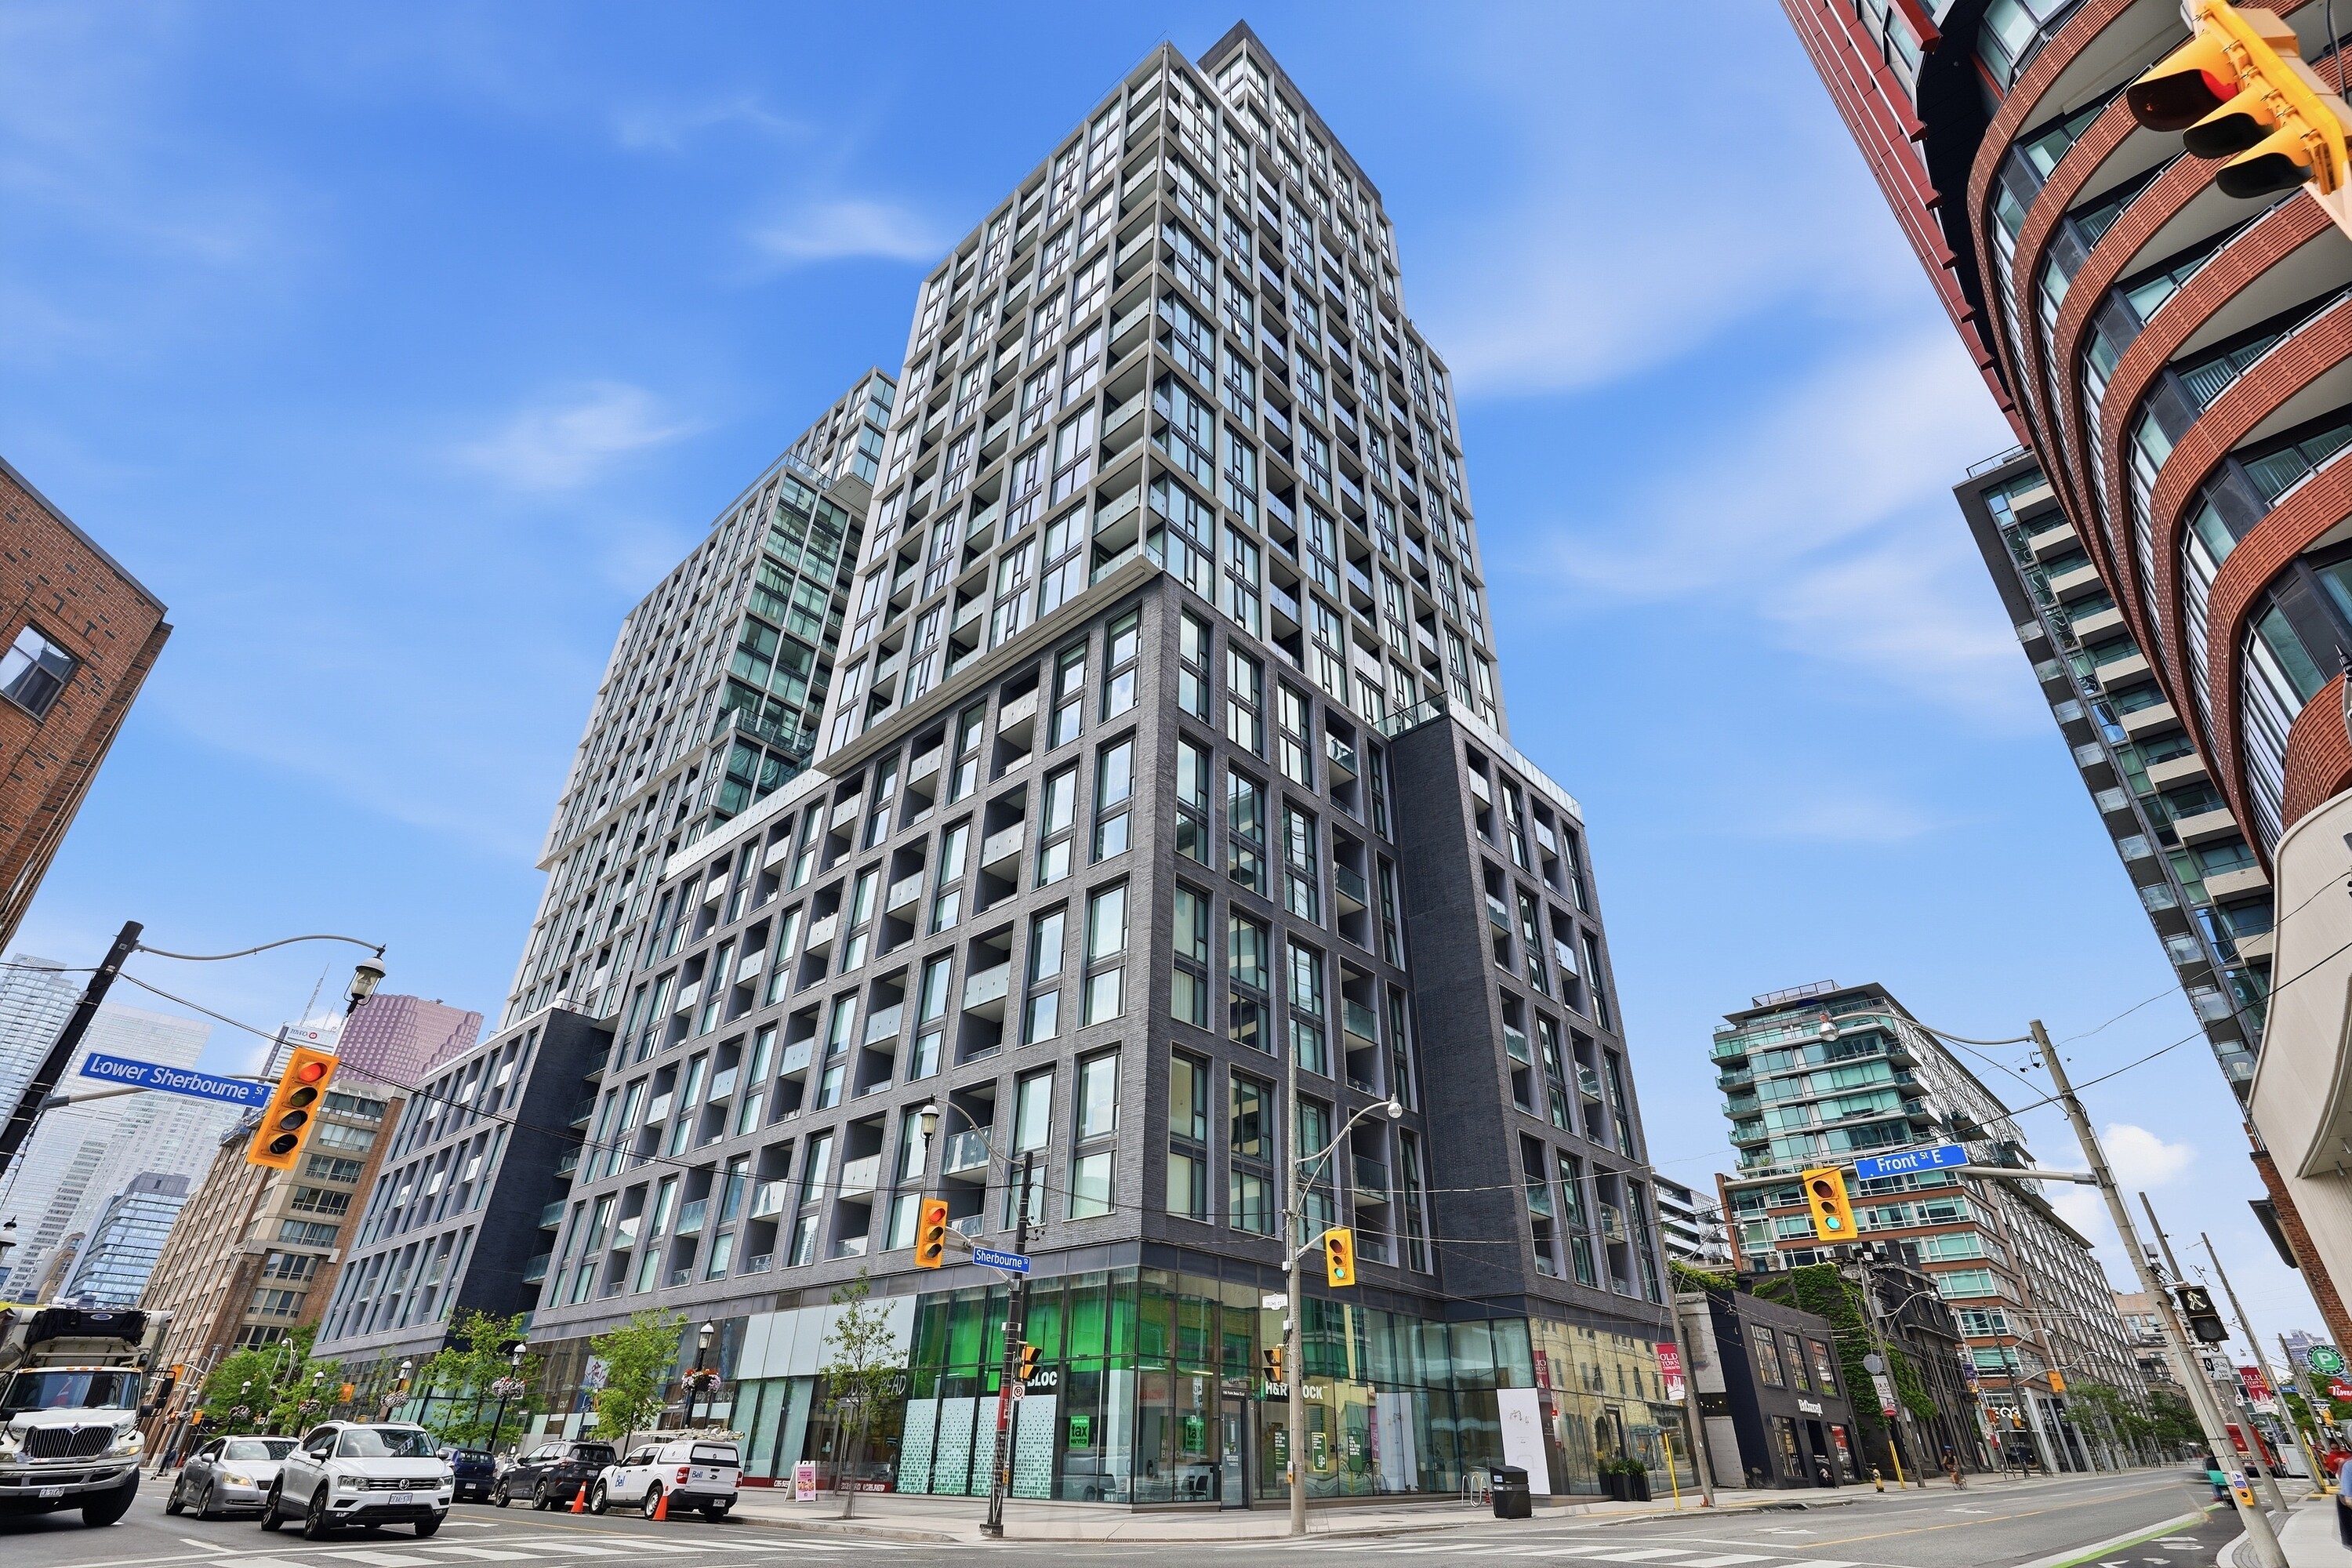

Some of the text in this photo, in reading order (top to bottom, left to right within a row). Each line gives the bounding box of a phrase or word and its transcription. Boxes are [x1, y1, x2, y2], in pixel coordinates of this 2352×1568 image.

[89, 1055, 148, 1080] Lower
[149, 1067, 250, 1100] Sherbourne
[1876, 1149, 1944, 1172] Front St E
[976, 1249, 1022, 1268] Sherbourne
[1660, 1352, 1679, 1361] OLD
[1071, 1424, 1088, 1437] tax
[691, 1470, 704, 1479] Bell
